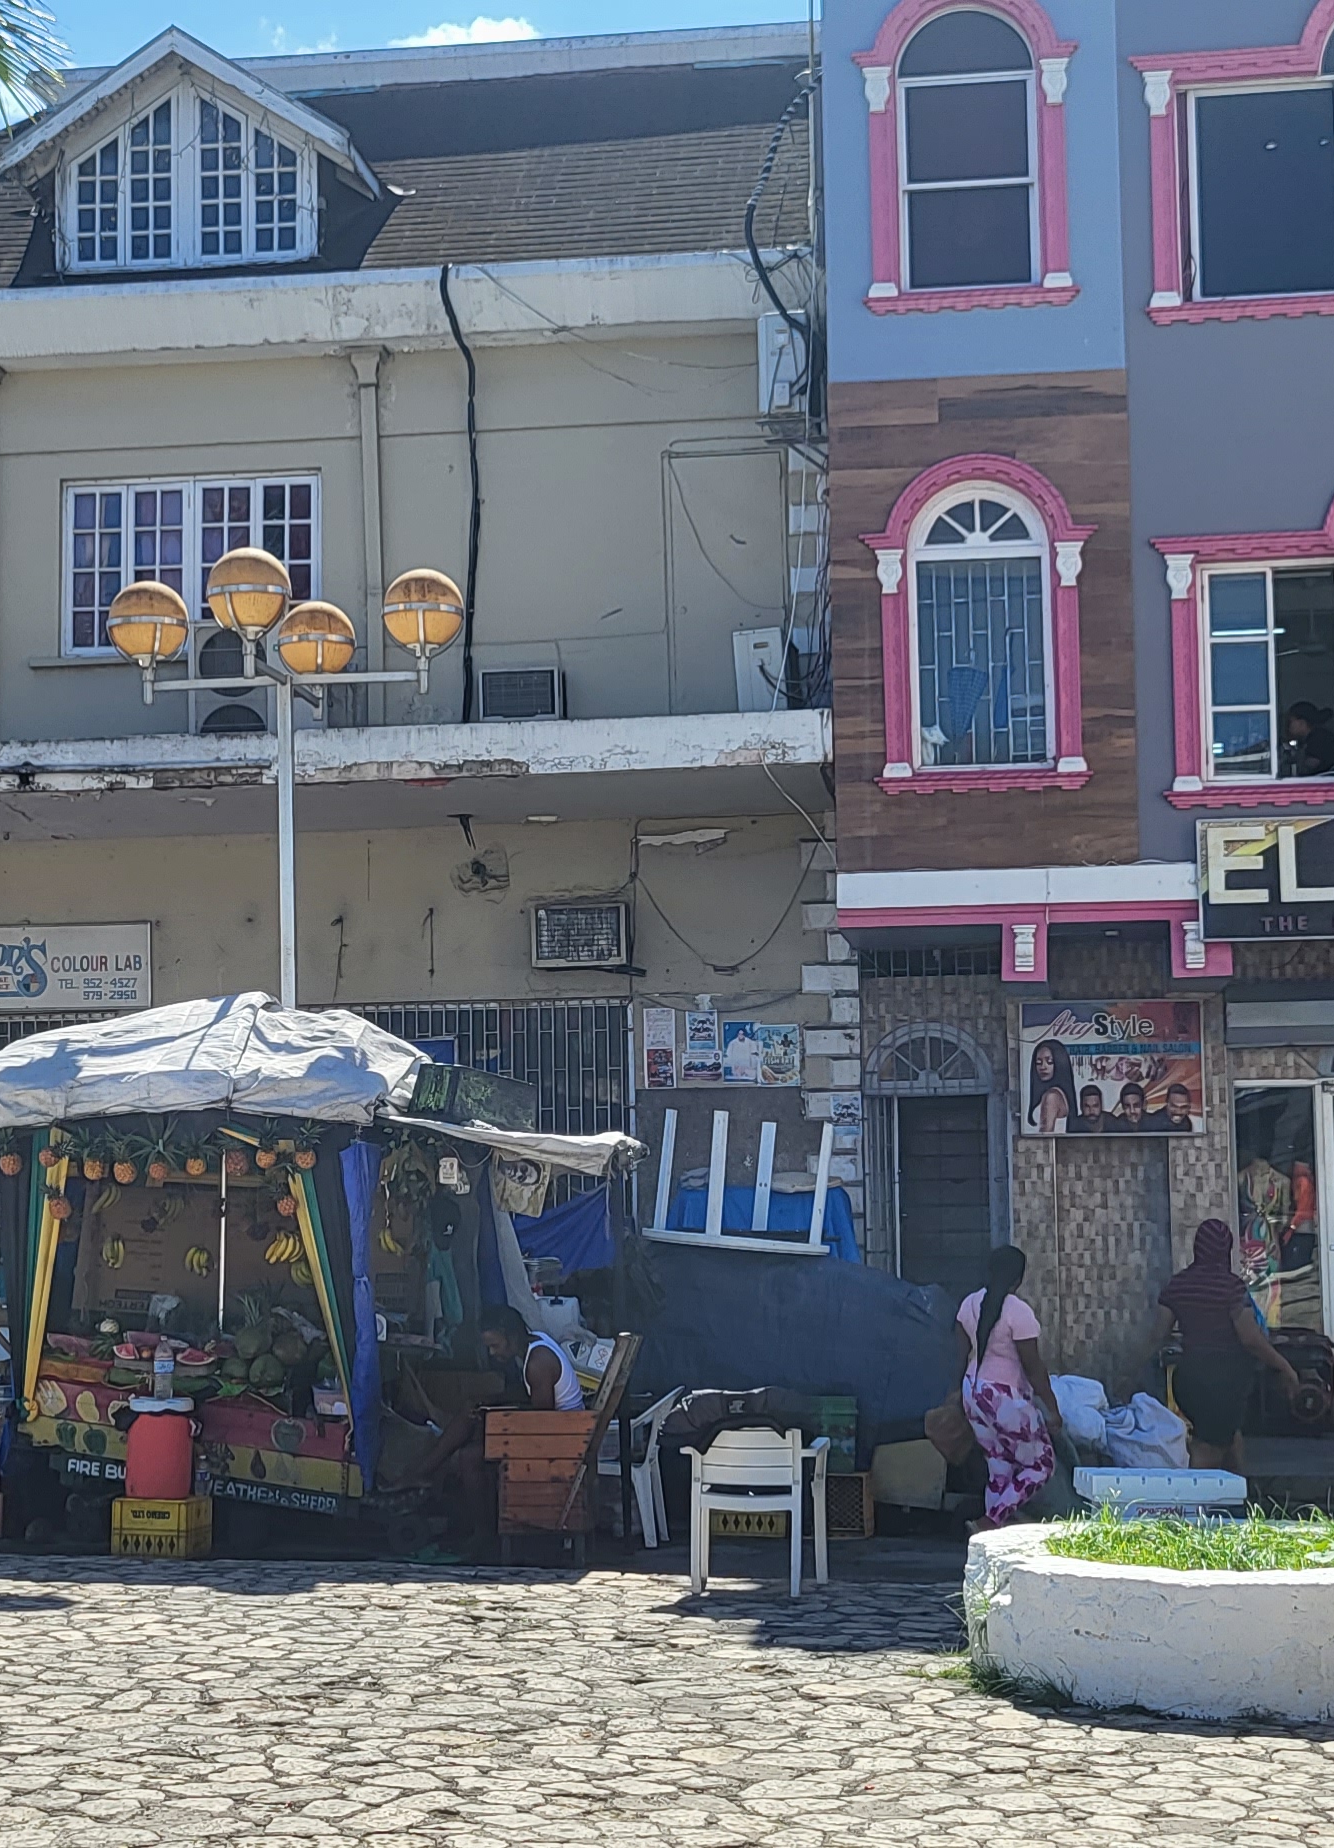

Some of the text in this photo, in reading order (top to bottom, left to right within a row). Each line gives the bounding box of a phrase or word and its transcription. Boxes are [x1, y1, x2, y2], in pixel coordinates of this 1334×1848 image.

[1260, 915, 1309, 933] THE
[50, 955, 143, 973] COLOUR LAB
[67, 1458, 127, 1480] FIRE BU
